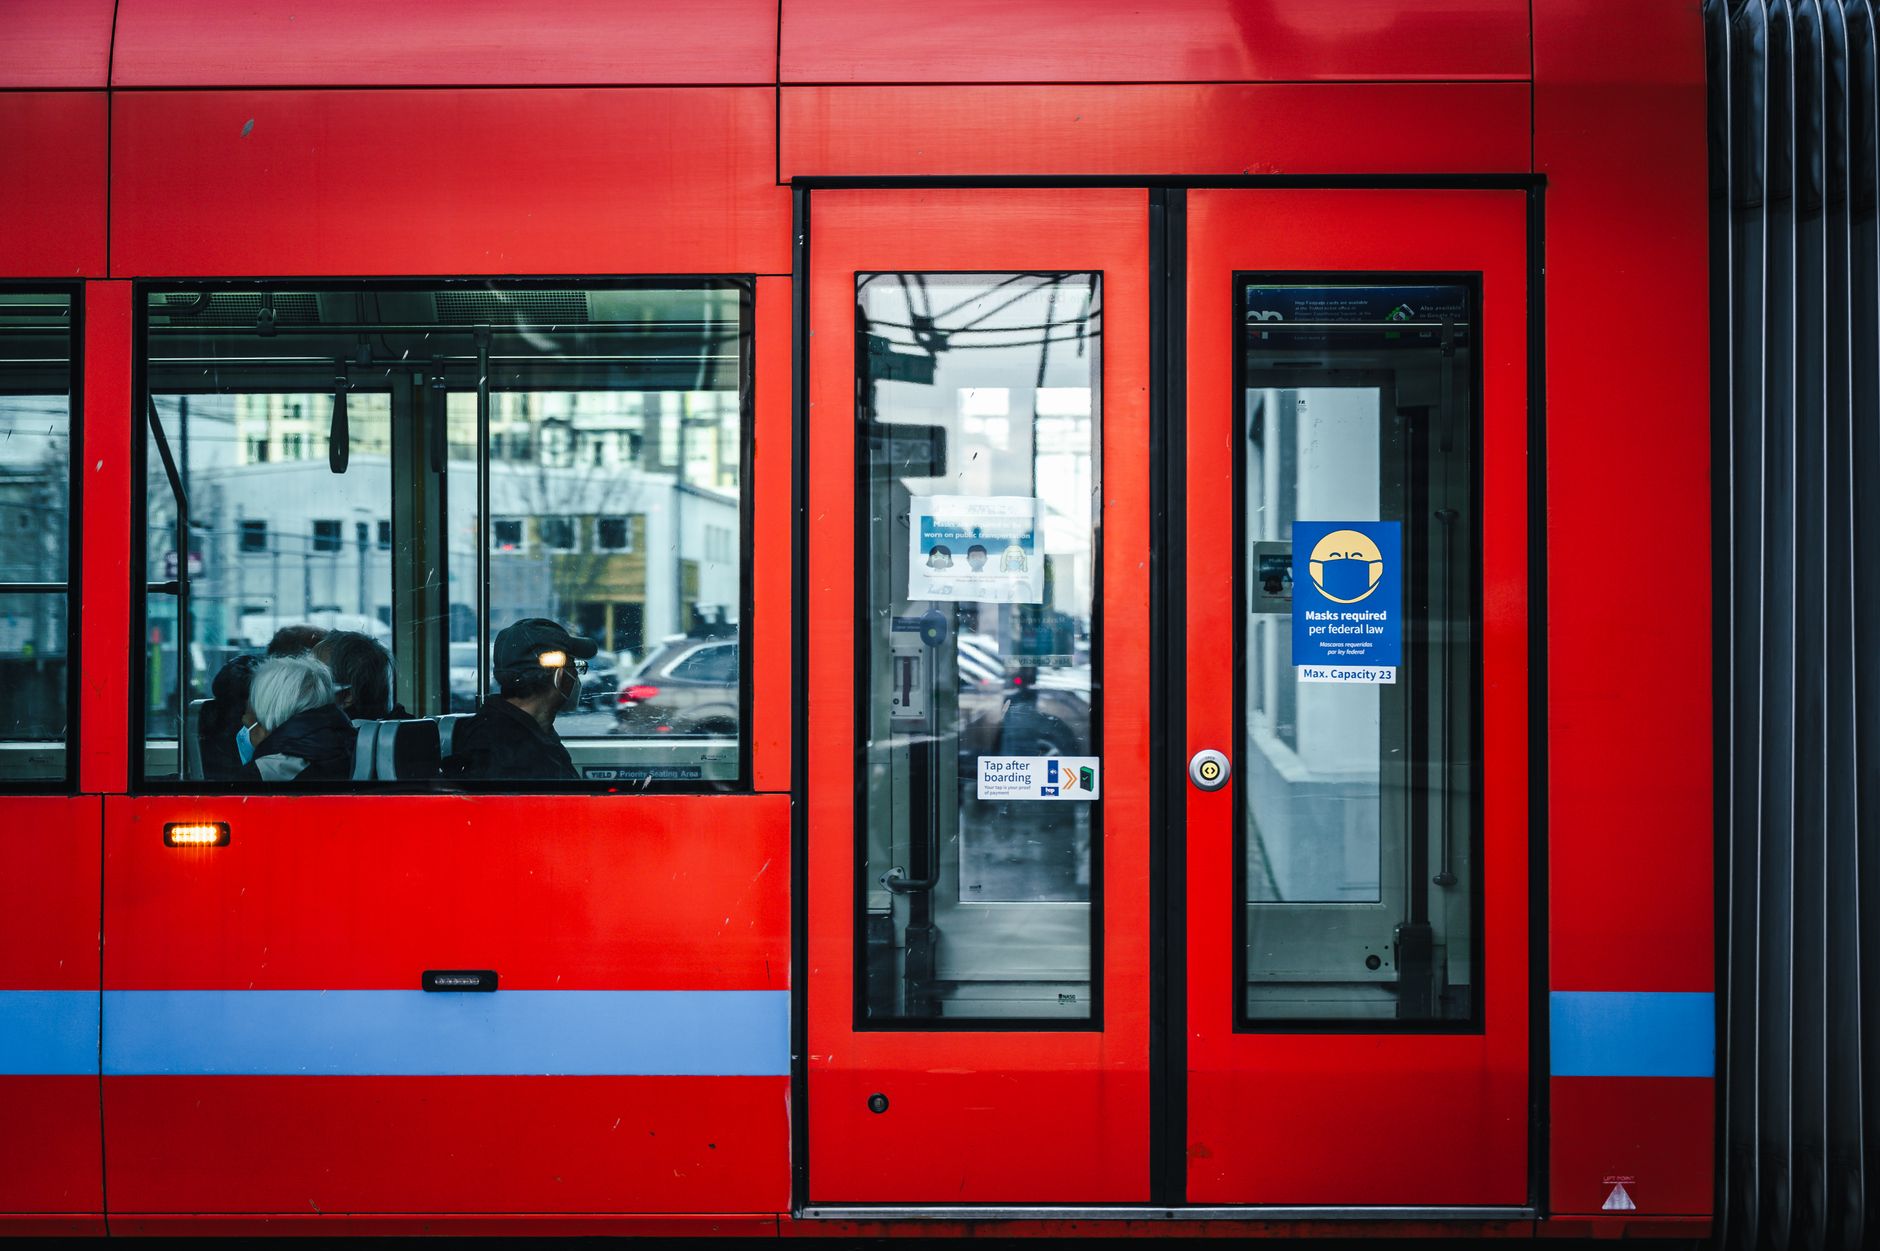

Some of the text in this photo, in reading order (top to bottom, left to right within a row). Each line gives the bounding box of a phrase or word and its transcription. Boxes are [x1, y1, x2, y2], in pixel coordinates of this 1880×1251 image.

[955, 530, 977, 540] public
[1305, 610, 1387, 622] Masks required
[1308, 624, 1384, 636] per federal law
[1303, 669, 1392, 681] Max. Capacity 23
[984, 760, 1030, 772] Tap after
[620, 770, 646, 779] Priority
[650, 770, 678, 779] Seating
[681, 770, 699, 778] Area
[984, 772, 1031, 784] boarding
